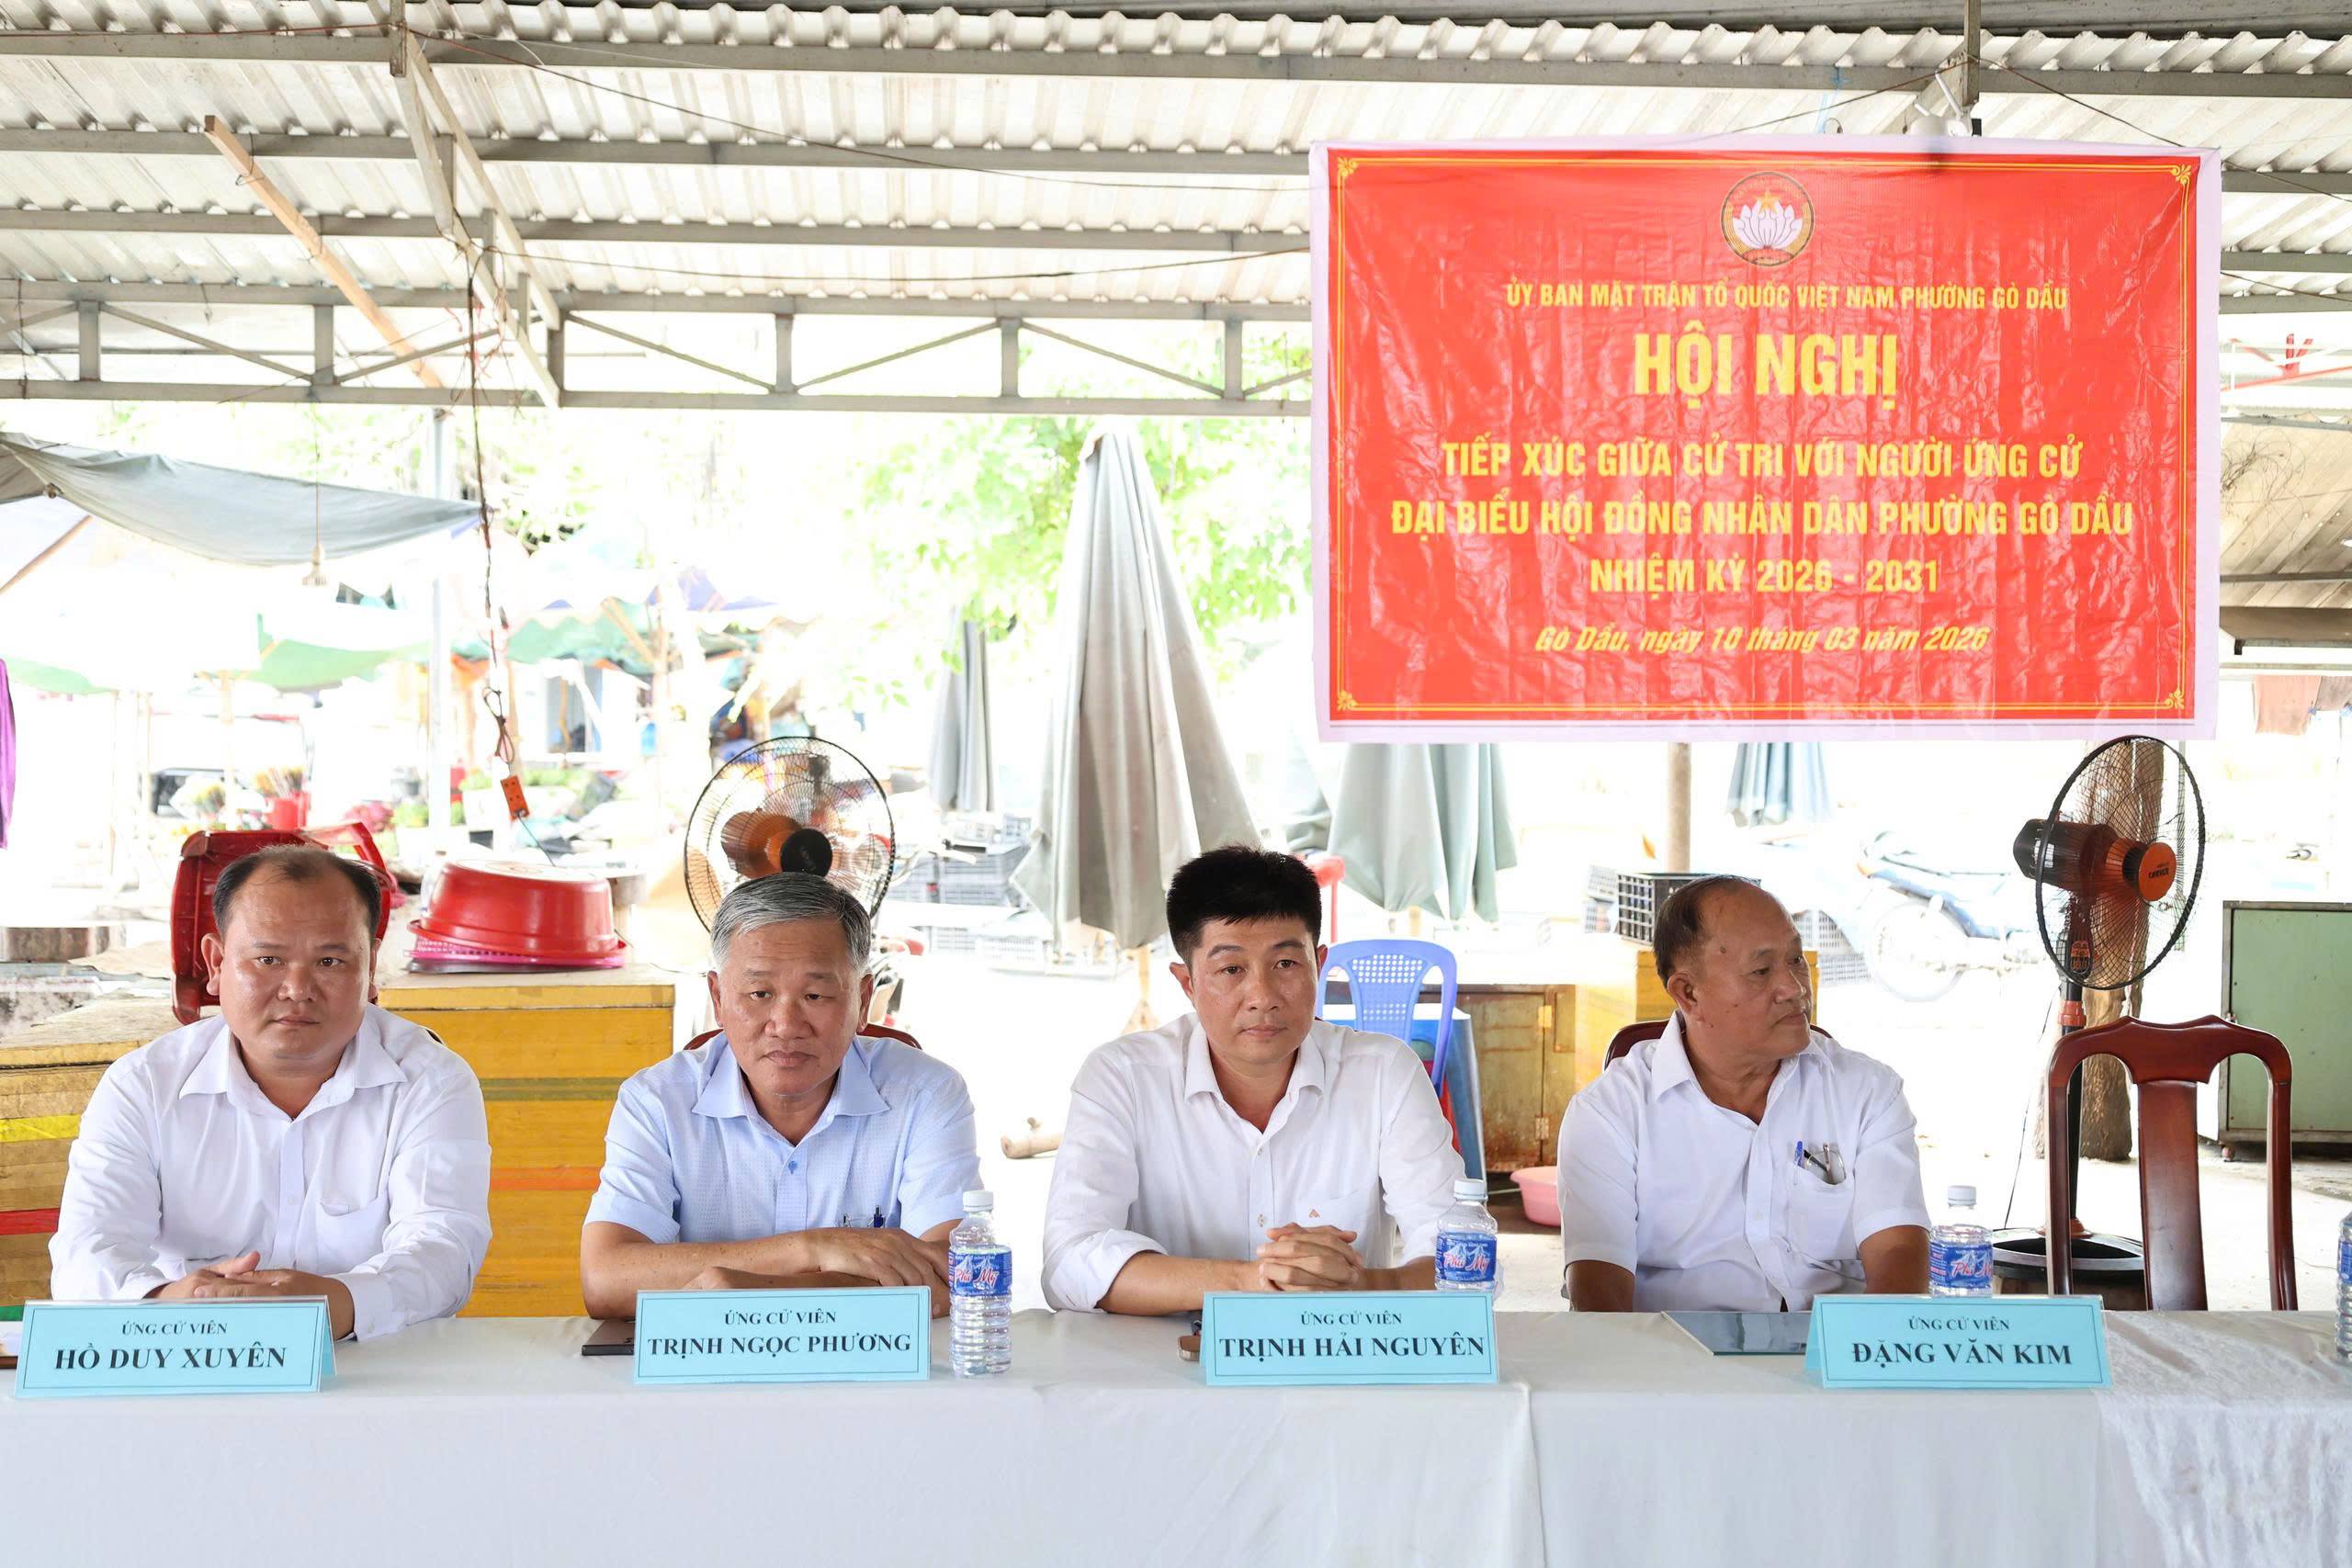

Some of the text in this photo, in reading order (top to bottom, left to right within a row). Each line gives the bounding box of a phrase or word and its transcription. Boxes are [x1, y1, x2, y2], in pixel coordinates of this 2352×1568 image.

[1506, 276, 1533, 307] ỦY
[1540, 283, 1583, 307] BAN
[1590, 279, 1636, 312] MẶT
[1641, 280, 1697, 312] TRẬN
[1702, 276, 1729, 307] TỔ
[1734, 278, 1791, 309] QUỐC
[1796, 281, 1840, 312] VIỆT
[1846, 285, 1894, 308] NAM
[1901, 282, 1985, 309] PHƯỜNG
[1992, 282, 2019, 310] GÒ
[1634, 319, 1897, 411] HỘI NGHỊ
[1441, 431, 2084, 479] TIẾP XÚC GIỮA CỬ TRI VỚI NGƯỜI ỨNG CỬ
[1391, 486, 2132, 542] ĐẠI BIỂU HỘI ĐỒNG NHÂN DÂN PHƯỜNG GÒ DẦU
[1590, 551, 1939, 600] NHIỆM KỲ 2026 - 2031
[1534, 626, 1571, 651] Gò
[1638, 626, 1704, 654] ngày
[1711, 626, 1744, 650] 10
[1746, 626, 1819, 653] tháng
[1823, 626, 1860, 651] 03
[1861, 626, 1919, 651] năm
[1922, 626, 1991, 651] 2026
[120, 1321, 228, 1337] ỨNG CỬ VIÊN
[725, 1308, 837, 1325] ỨNG CỬ VIÊN
[1301, 1310, 1403, 1325] ỨNG CỬ VIÊN
[1908, 1315, 2010, 1331] ỨNG CỬ VIÊN
[109, 1348, 174, 1370] DUY
[181, 1340, 288, 1369] XUYÊN
[648, 1332, 911, 1359] TRỊNH NGỌC PHƯƠNG
[1218, 1331, 1485, 1362] TRỊNH HẢI NGUYÊN
[1852, 1338, 2073, 1369] ĐẶNG VĂN KIM
